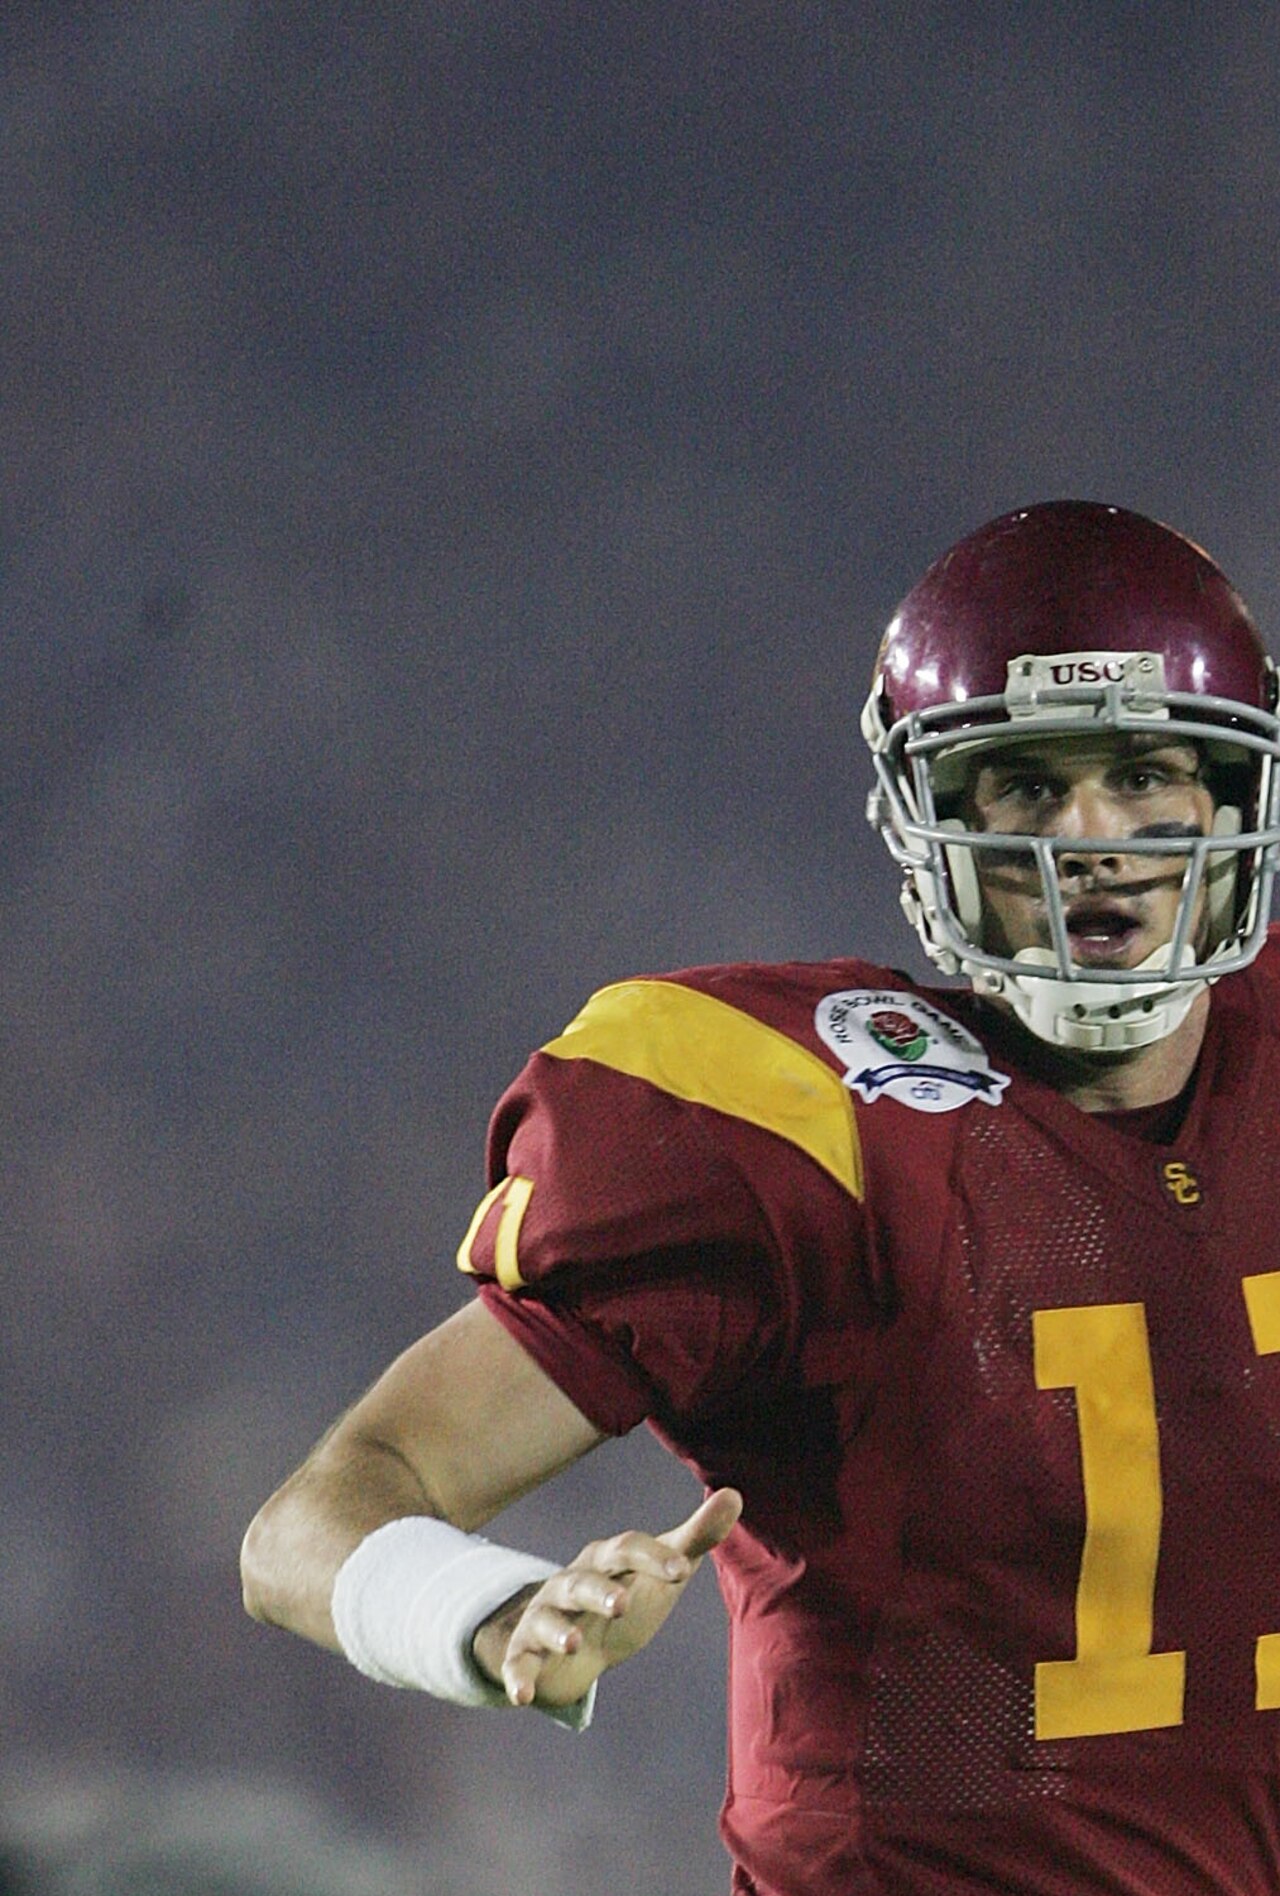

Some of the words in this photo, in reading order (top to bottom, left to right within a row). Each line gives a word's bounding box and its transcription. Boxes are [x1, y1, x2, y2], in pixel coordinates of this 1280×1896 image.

[1050, 661, 1126, 685] USC
[829, 1005, 853, 1044] ROSE
[842, 996, 904, 1009] BOWL
